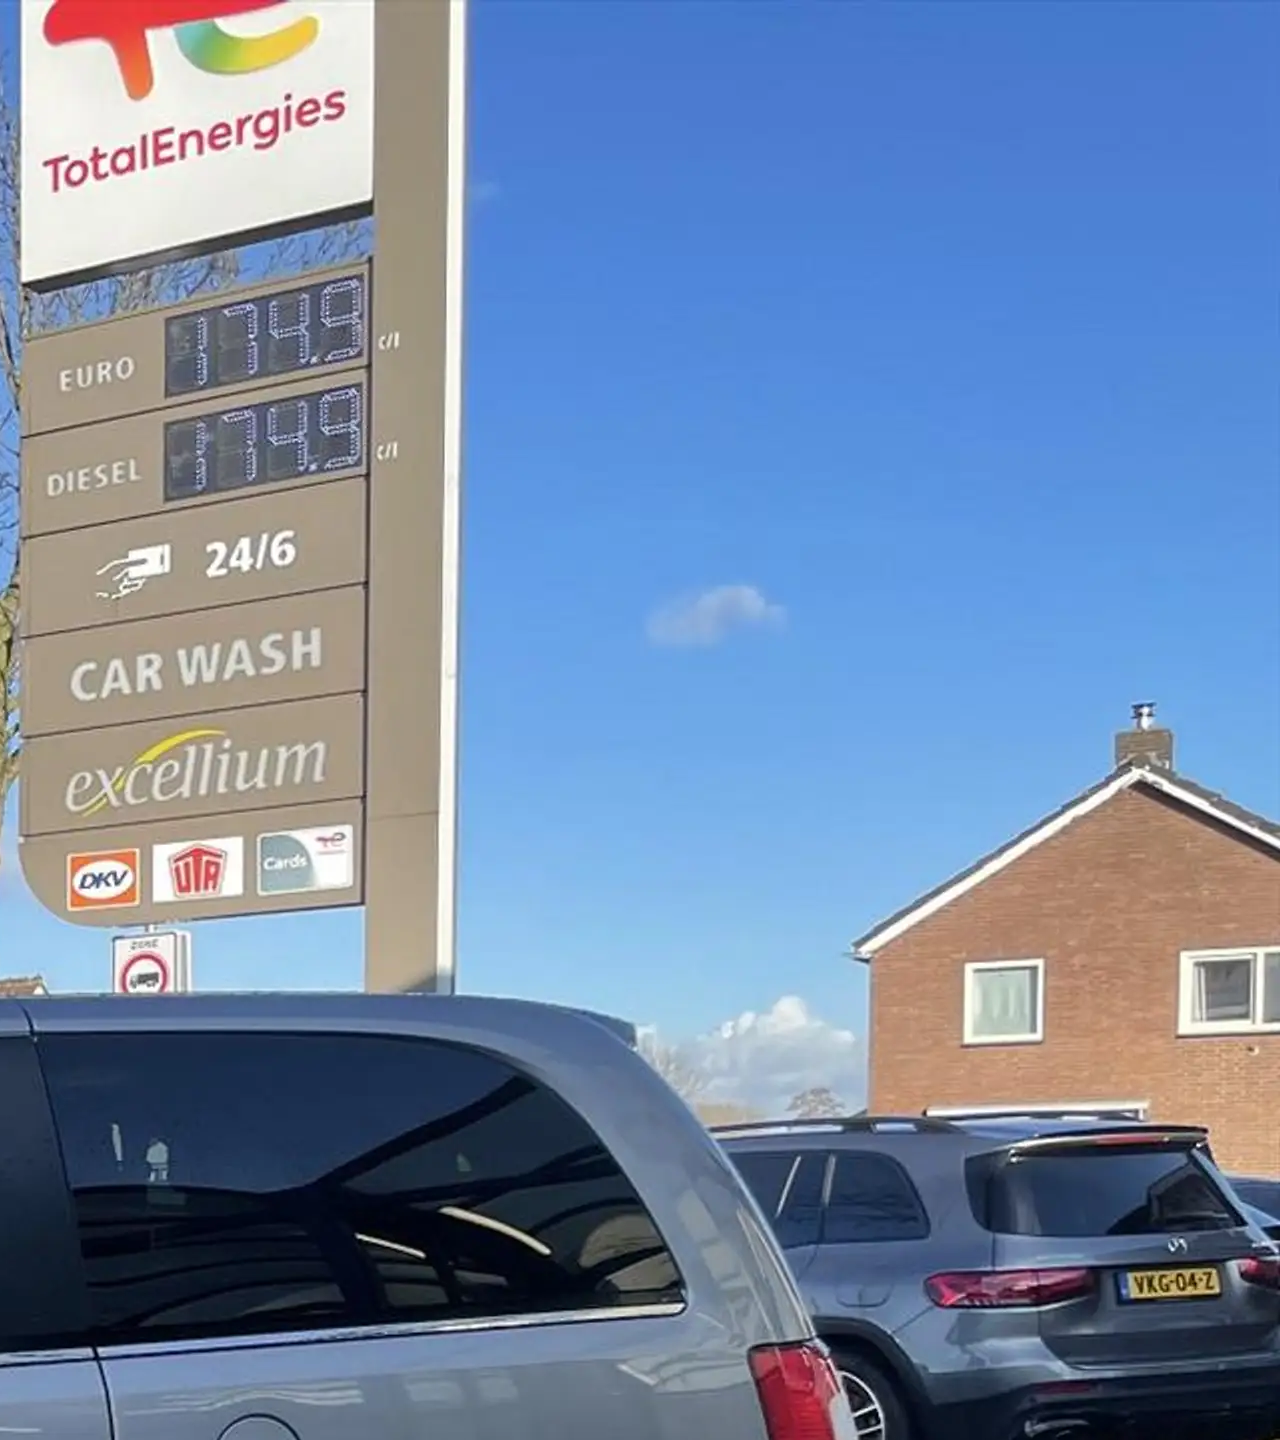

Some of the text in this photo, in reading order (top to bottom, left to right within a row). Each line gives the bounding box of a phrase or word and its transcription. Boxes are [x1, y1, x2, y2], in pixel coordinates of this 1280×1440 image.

[42, 89, 347, 193] TotalEnergies
[58, 356, 136, 393] EURO
[46, 457, 143, 498] DIESEL
[204, 529, 297, 578] 24/6
[69, 626, 323, 702] CAR WASH
[64, 738, 327, 813] excellium
[77, 868, 129, 890] DKV
[172, 846, 225, 895] UTA
[263, 853, 309, 871] Cards
[1133, 1270, 1215, 1295] VKG-04-Z
